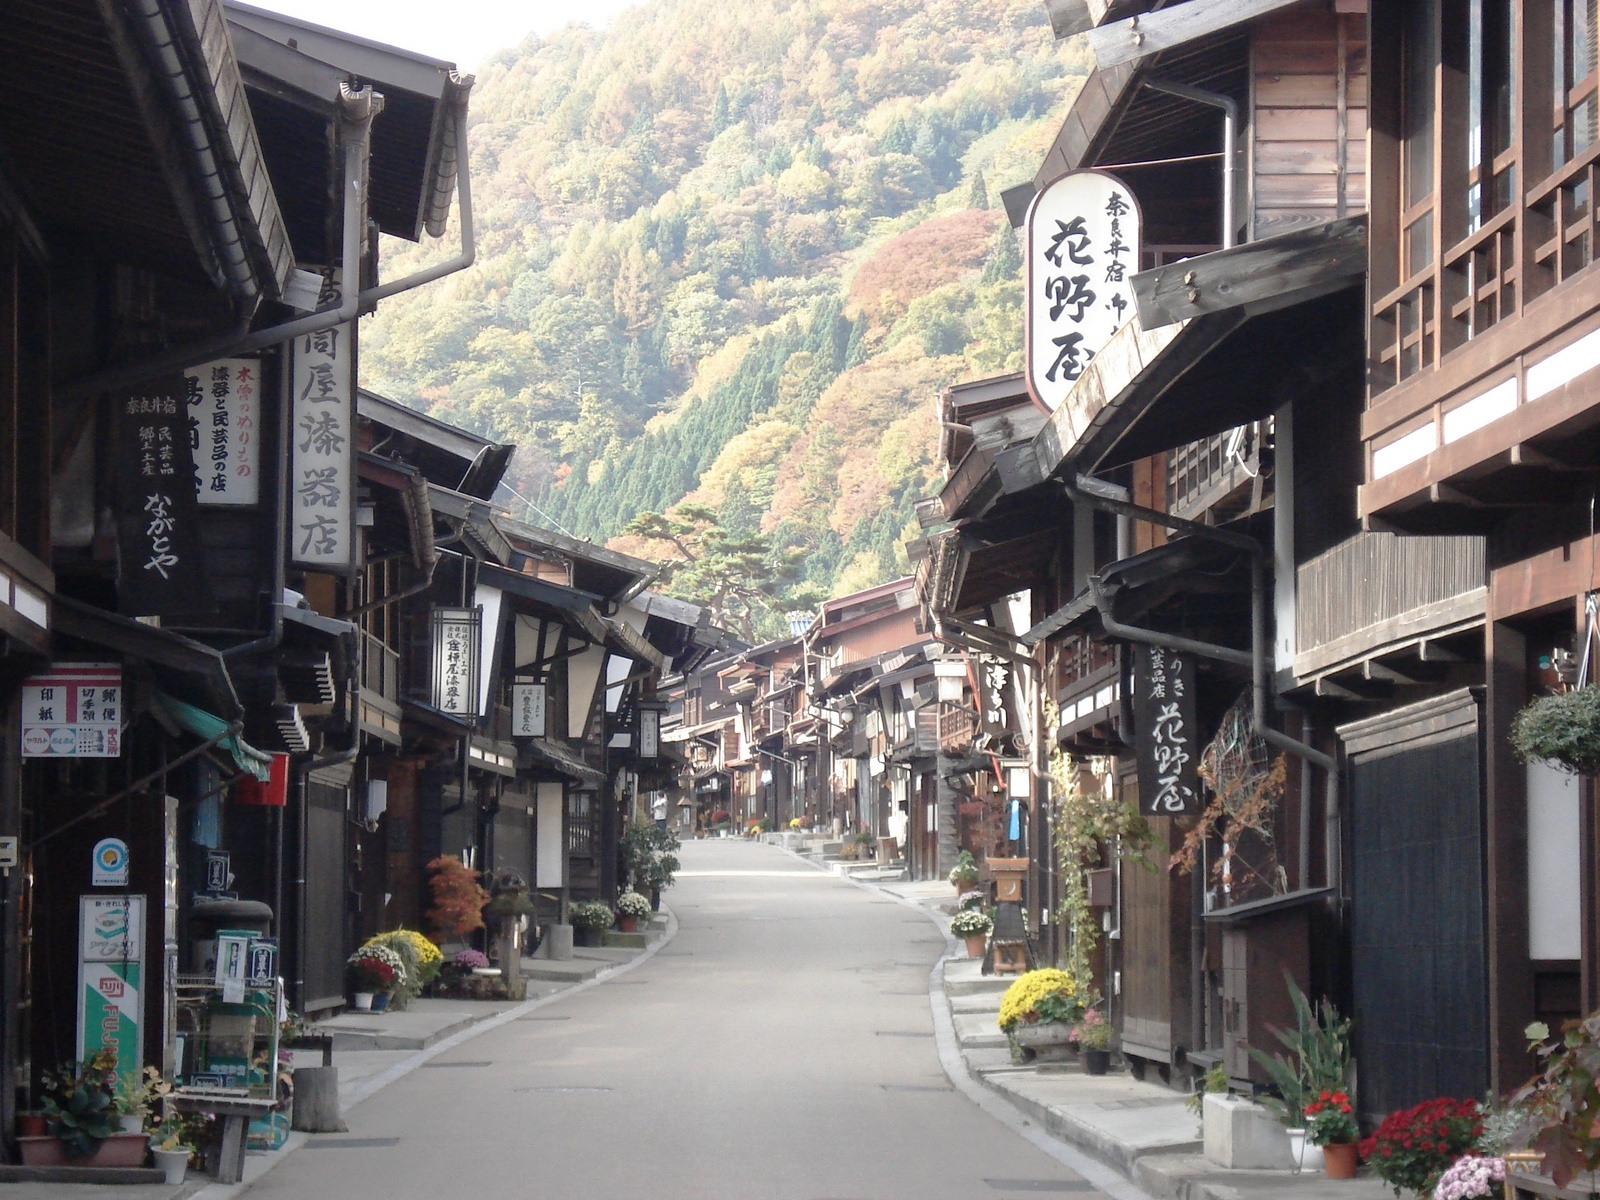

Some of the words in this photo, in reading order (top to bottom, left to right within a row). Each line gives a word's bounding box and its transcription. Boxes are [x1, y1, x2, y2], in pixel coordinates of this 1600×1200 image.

[1104, 191, 1130, 283] 奈良井宿
[1044, 216, 1096, 382] 花野屋
[127, 396, 176, 414] 奈良井宿
[210, 366, 230, 492] 漆器と民芸品の店
[158, 426, 174, 475] 民芸品
[144, 493, 178, 579] ながとや
[38, 688, 53, 721] 印紙
[82, 688, 95, 721] 切手類
[102, 688, 117, 721] 郵便
[1151, 702, 1193, 812] 花野屋
